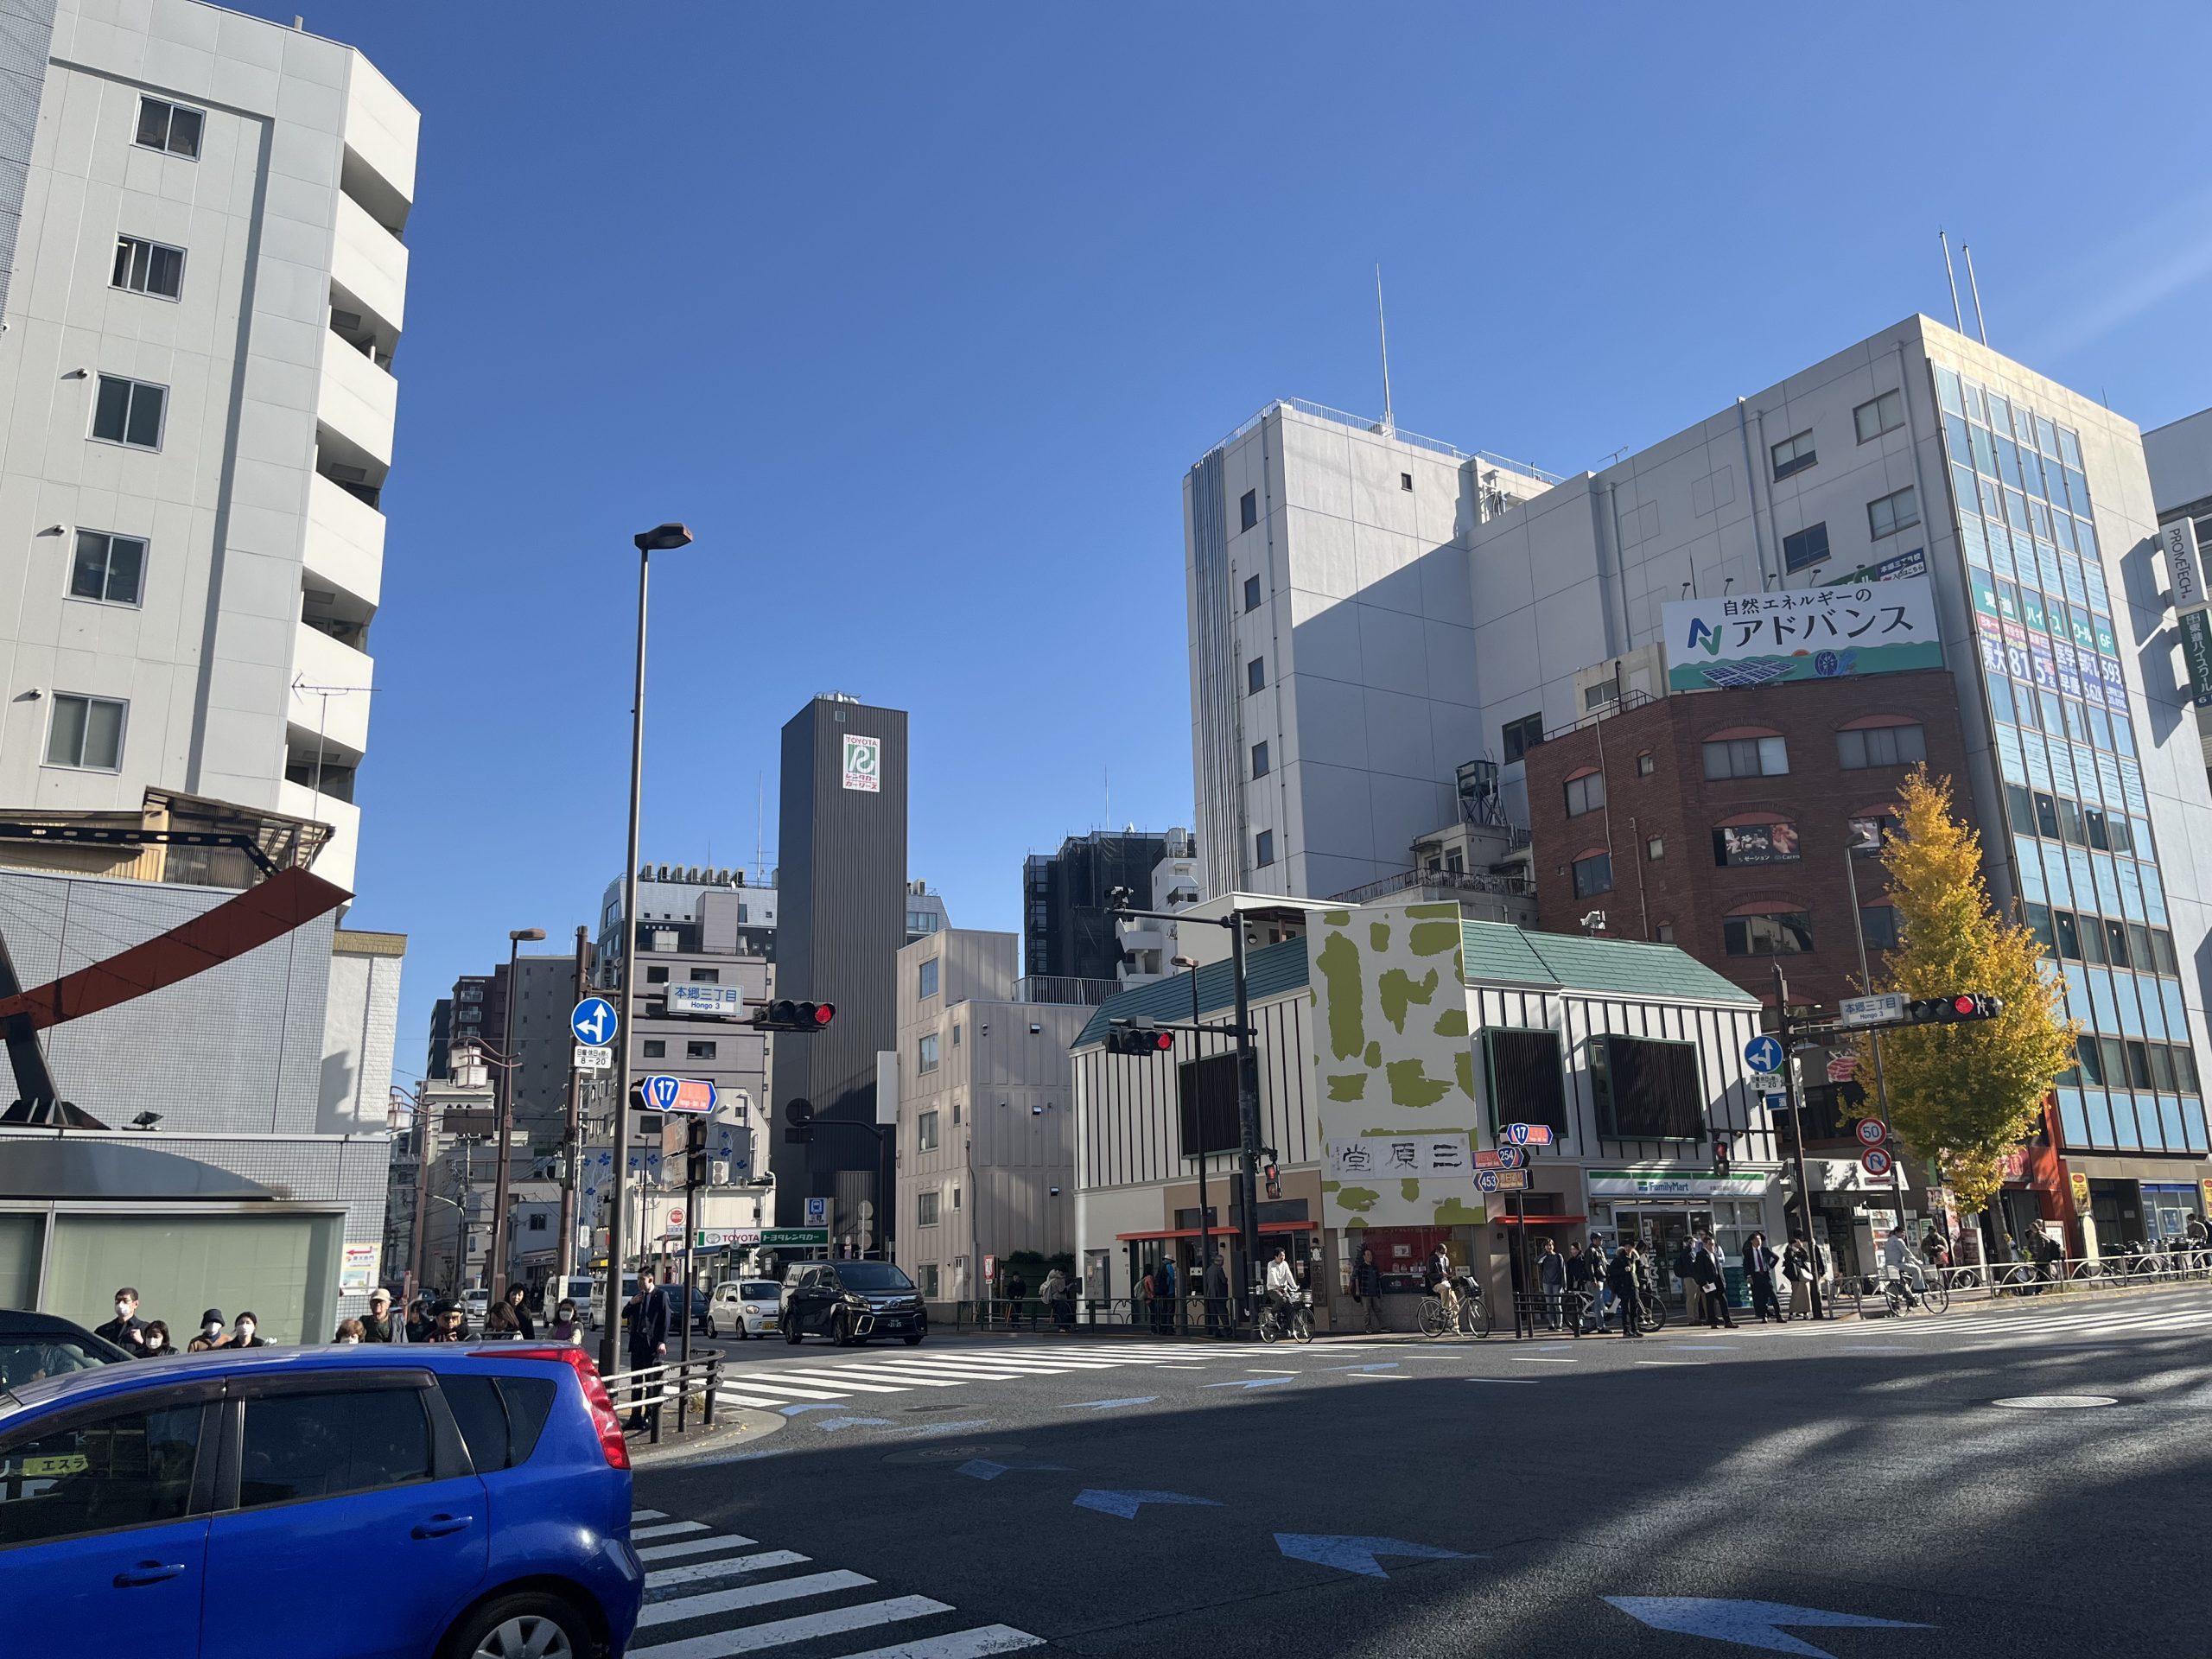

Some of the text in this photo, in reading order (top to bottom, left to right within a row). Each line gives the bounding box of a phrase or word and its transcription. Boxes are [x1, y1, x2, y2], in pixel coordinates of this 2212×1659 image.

[1723, 588, 1872, 617] 自然エネルギーの
[1732, 606, 1914, 648] アドバンス
[2100, 633, 2112, 648] 6F
[847, 737, 878, 747] TOYOTA
[675, 986, 737, 1002] 本郷三丁目
[1845, 997, 1896, 1014] 本郷三丁目
[658, 1080, 675, 1101] 17
[1516, 1126, 1526, 1140] 17
[1862, 1125, 1879, 1139] 50
[1499, 1150, 1514, 1160] 254
[1481, 1175, 1497, 1187] 453
[1649, 1182, 1689, 1192] FamilyMart
